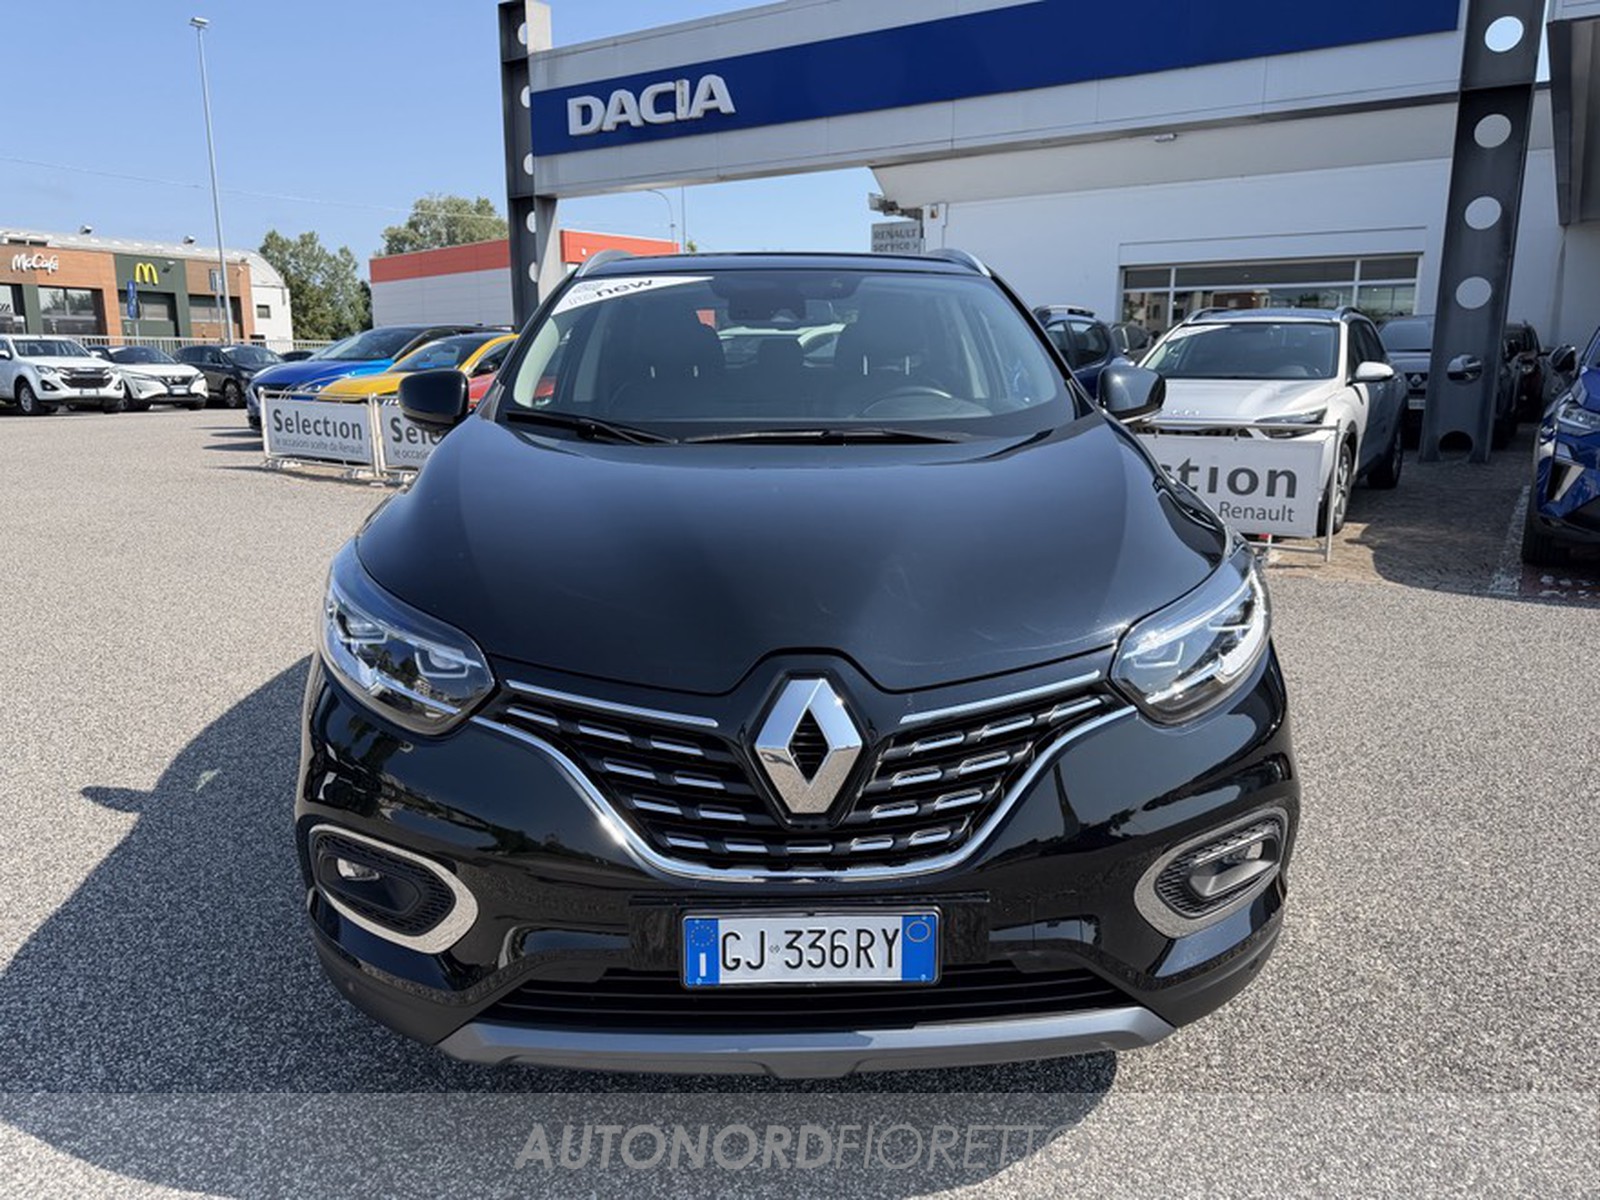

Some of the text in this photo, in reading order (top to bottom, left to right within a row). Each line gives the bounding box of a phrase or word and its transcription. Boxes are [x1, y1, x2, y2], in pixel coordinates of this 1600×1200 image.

[567, 74, 736, 136] DACIA
[272, 408, 363, 440] Selection
[1219, 501, 1295, 522] Renault
